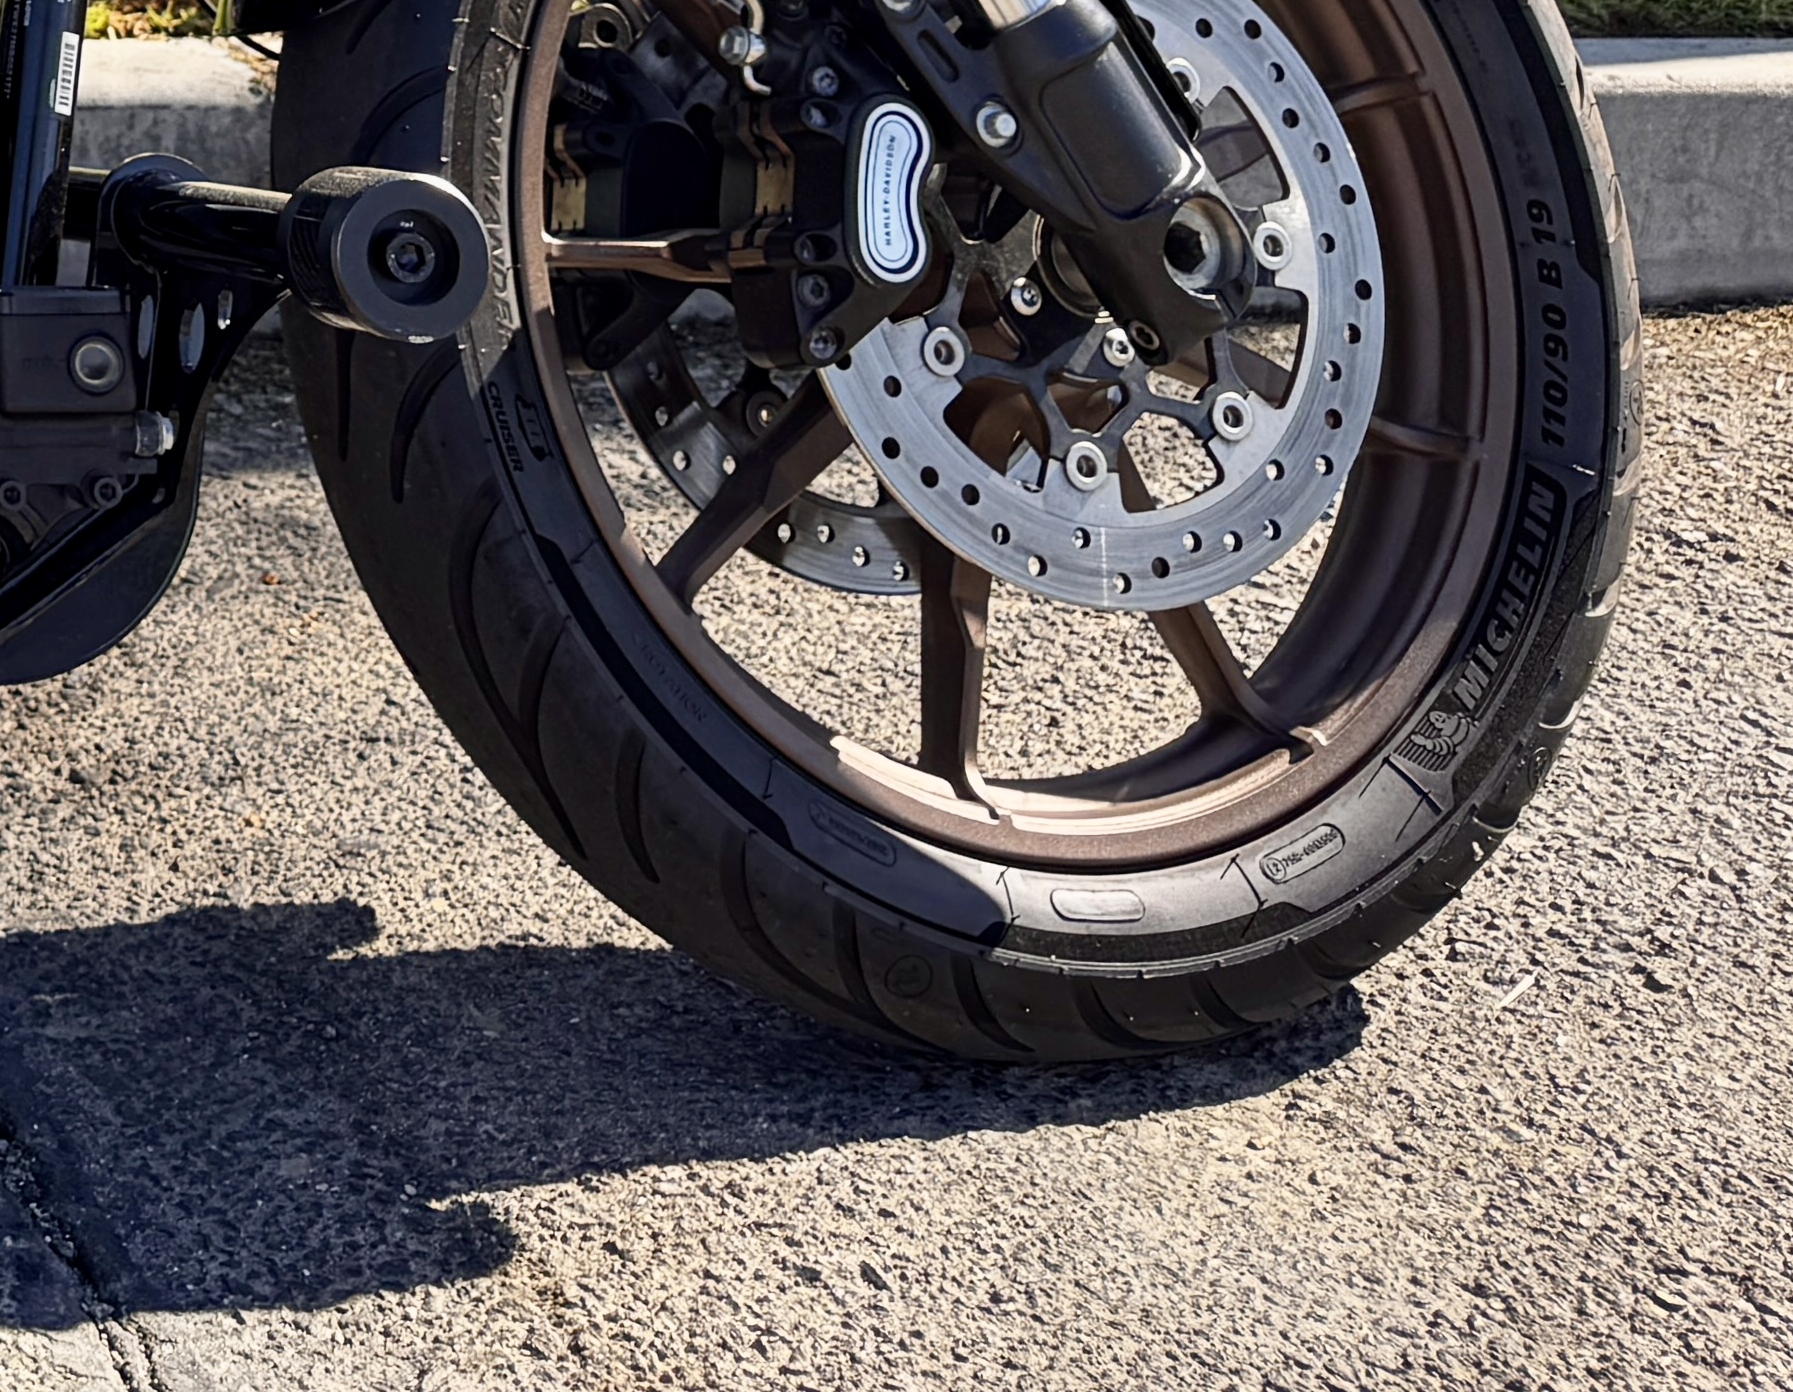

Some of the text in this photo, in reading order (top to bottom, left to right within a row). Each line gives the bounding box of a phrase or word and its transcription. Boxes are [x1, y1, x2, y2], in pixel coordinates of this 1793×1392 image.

[882, 134, 897, 246] HARLEY-DAVIDSON
[1525, 199, 1570, 447] 110/90 B 19
[485, 380, 526, 474] CRUISER
[1453, 488, 1560, 715] MICHELIN
